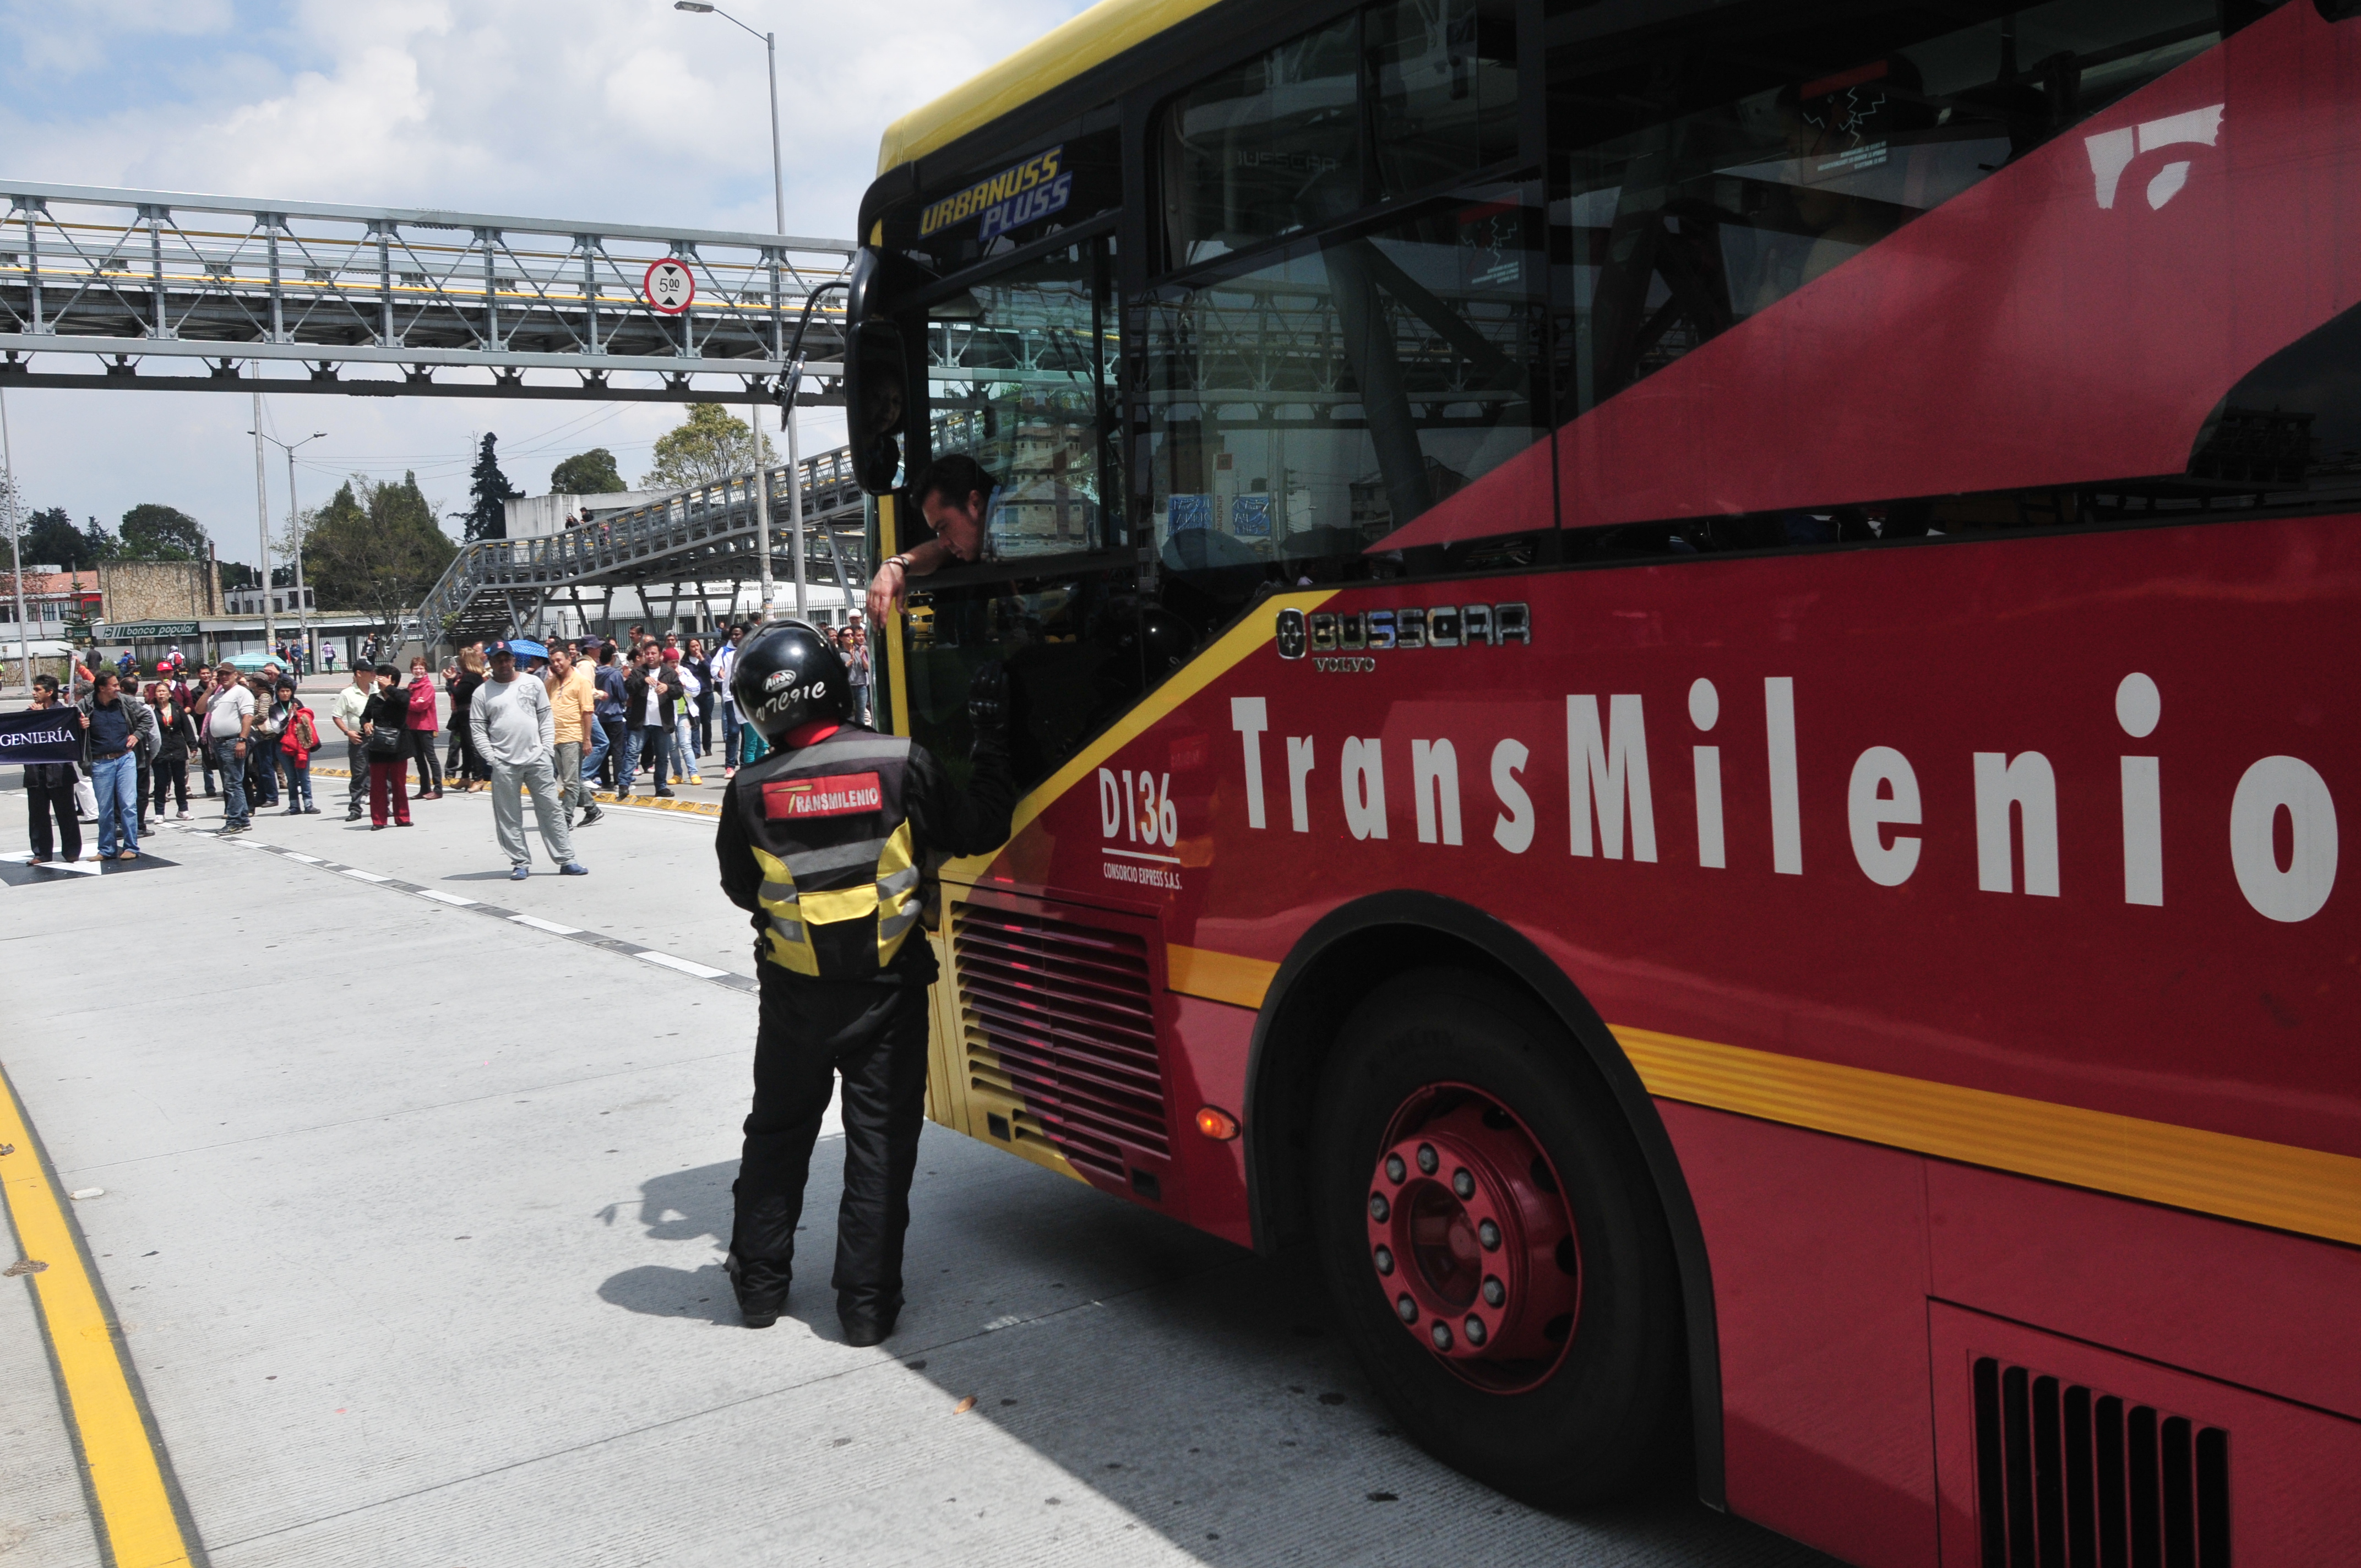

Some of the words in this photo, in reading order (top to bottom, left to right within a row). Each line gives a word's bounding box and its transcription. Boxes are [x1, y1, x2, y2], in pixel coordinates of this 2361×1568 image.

[921, 148, 1061, 236] URBANUSS
[981, 174, 1071, 238] PLUSS
[127, 625, 155, 635] banco
[159, 623, 195, 636] popular
[1310, 601, 1531, 651] BUSSCAR
[765, 671, 794, 690] Airoh
[1312, 657, 1375, 672] VOLVO
[768, 783, 879, 814] TRANSMILENIO
[1098, 767, 1178, 848] D136
[1231, 671, 2339, 923] TransMilenio
[1103, 862, 1138, 883] CONSORCIO
[1138, 867, 1163, 887] EXPRESS
[1164, 871, 1183, 890] S.A.S.
